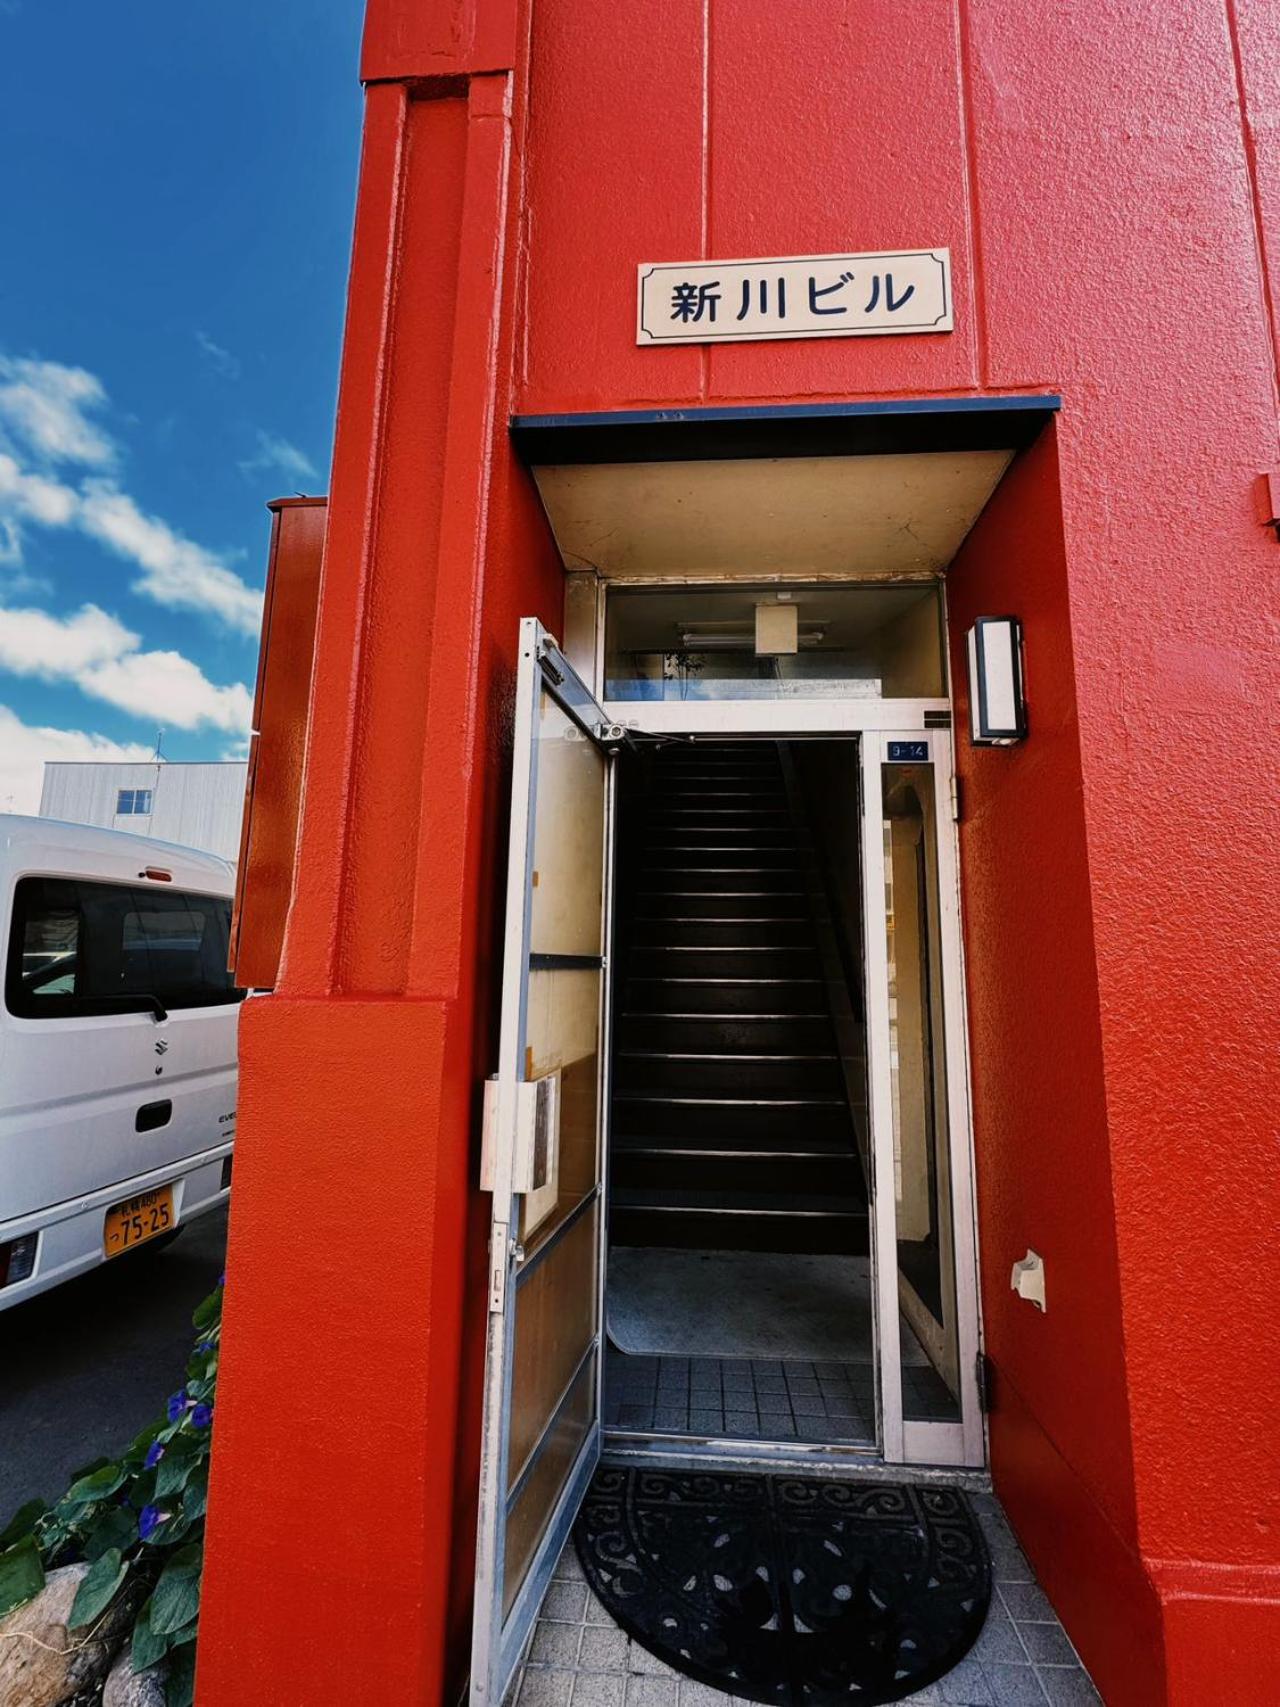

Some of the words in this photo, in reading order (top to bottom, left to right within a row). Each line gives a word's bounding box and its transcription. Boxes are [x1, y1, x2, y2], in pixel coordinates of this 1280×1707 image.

[670, 271, 915, 323] 新川ビル
[121, 1202, 169, 1246] 75-25
